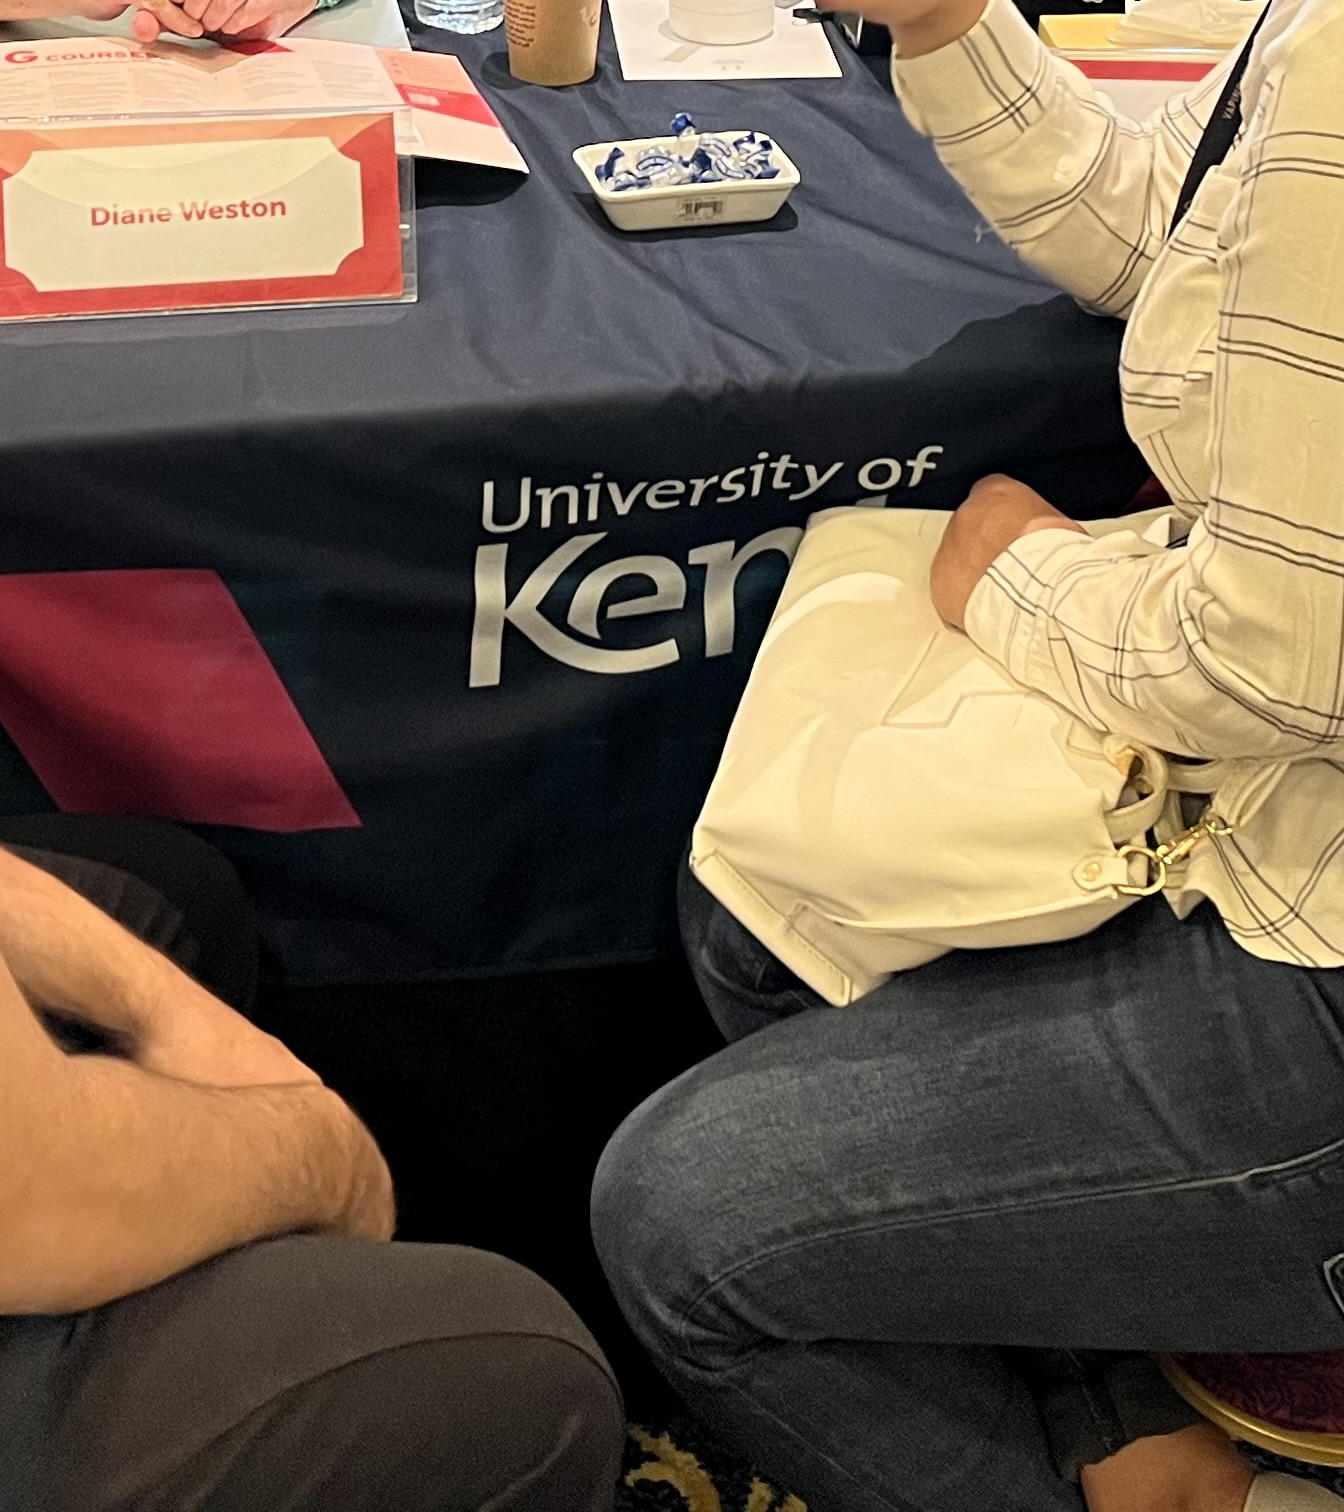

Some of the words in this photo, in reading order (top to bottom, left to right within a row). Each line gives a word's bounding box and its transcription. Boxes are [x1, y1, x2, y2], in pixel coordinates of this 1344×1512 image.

[46, 51, 153, 62] COURSE
[90, 204, 173, 226] Diane
[179, 199, 287, 223] Weston
[481, 450, 843, 533] University
[858, 445, 943, 490] of
[469, 525, 808, 688] Ken
